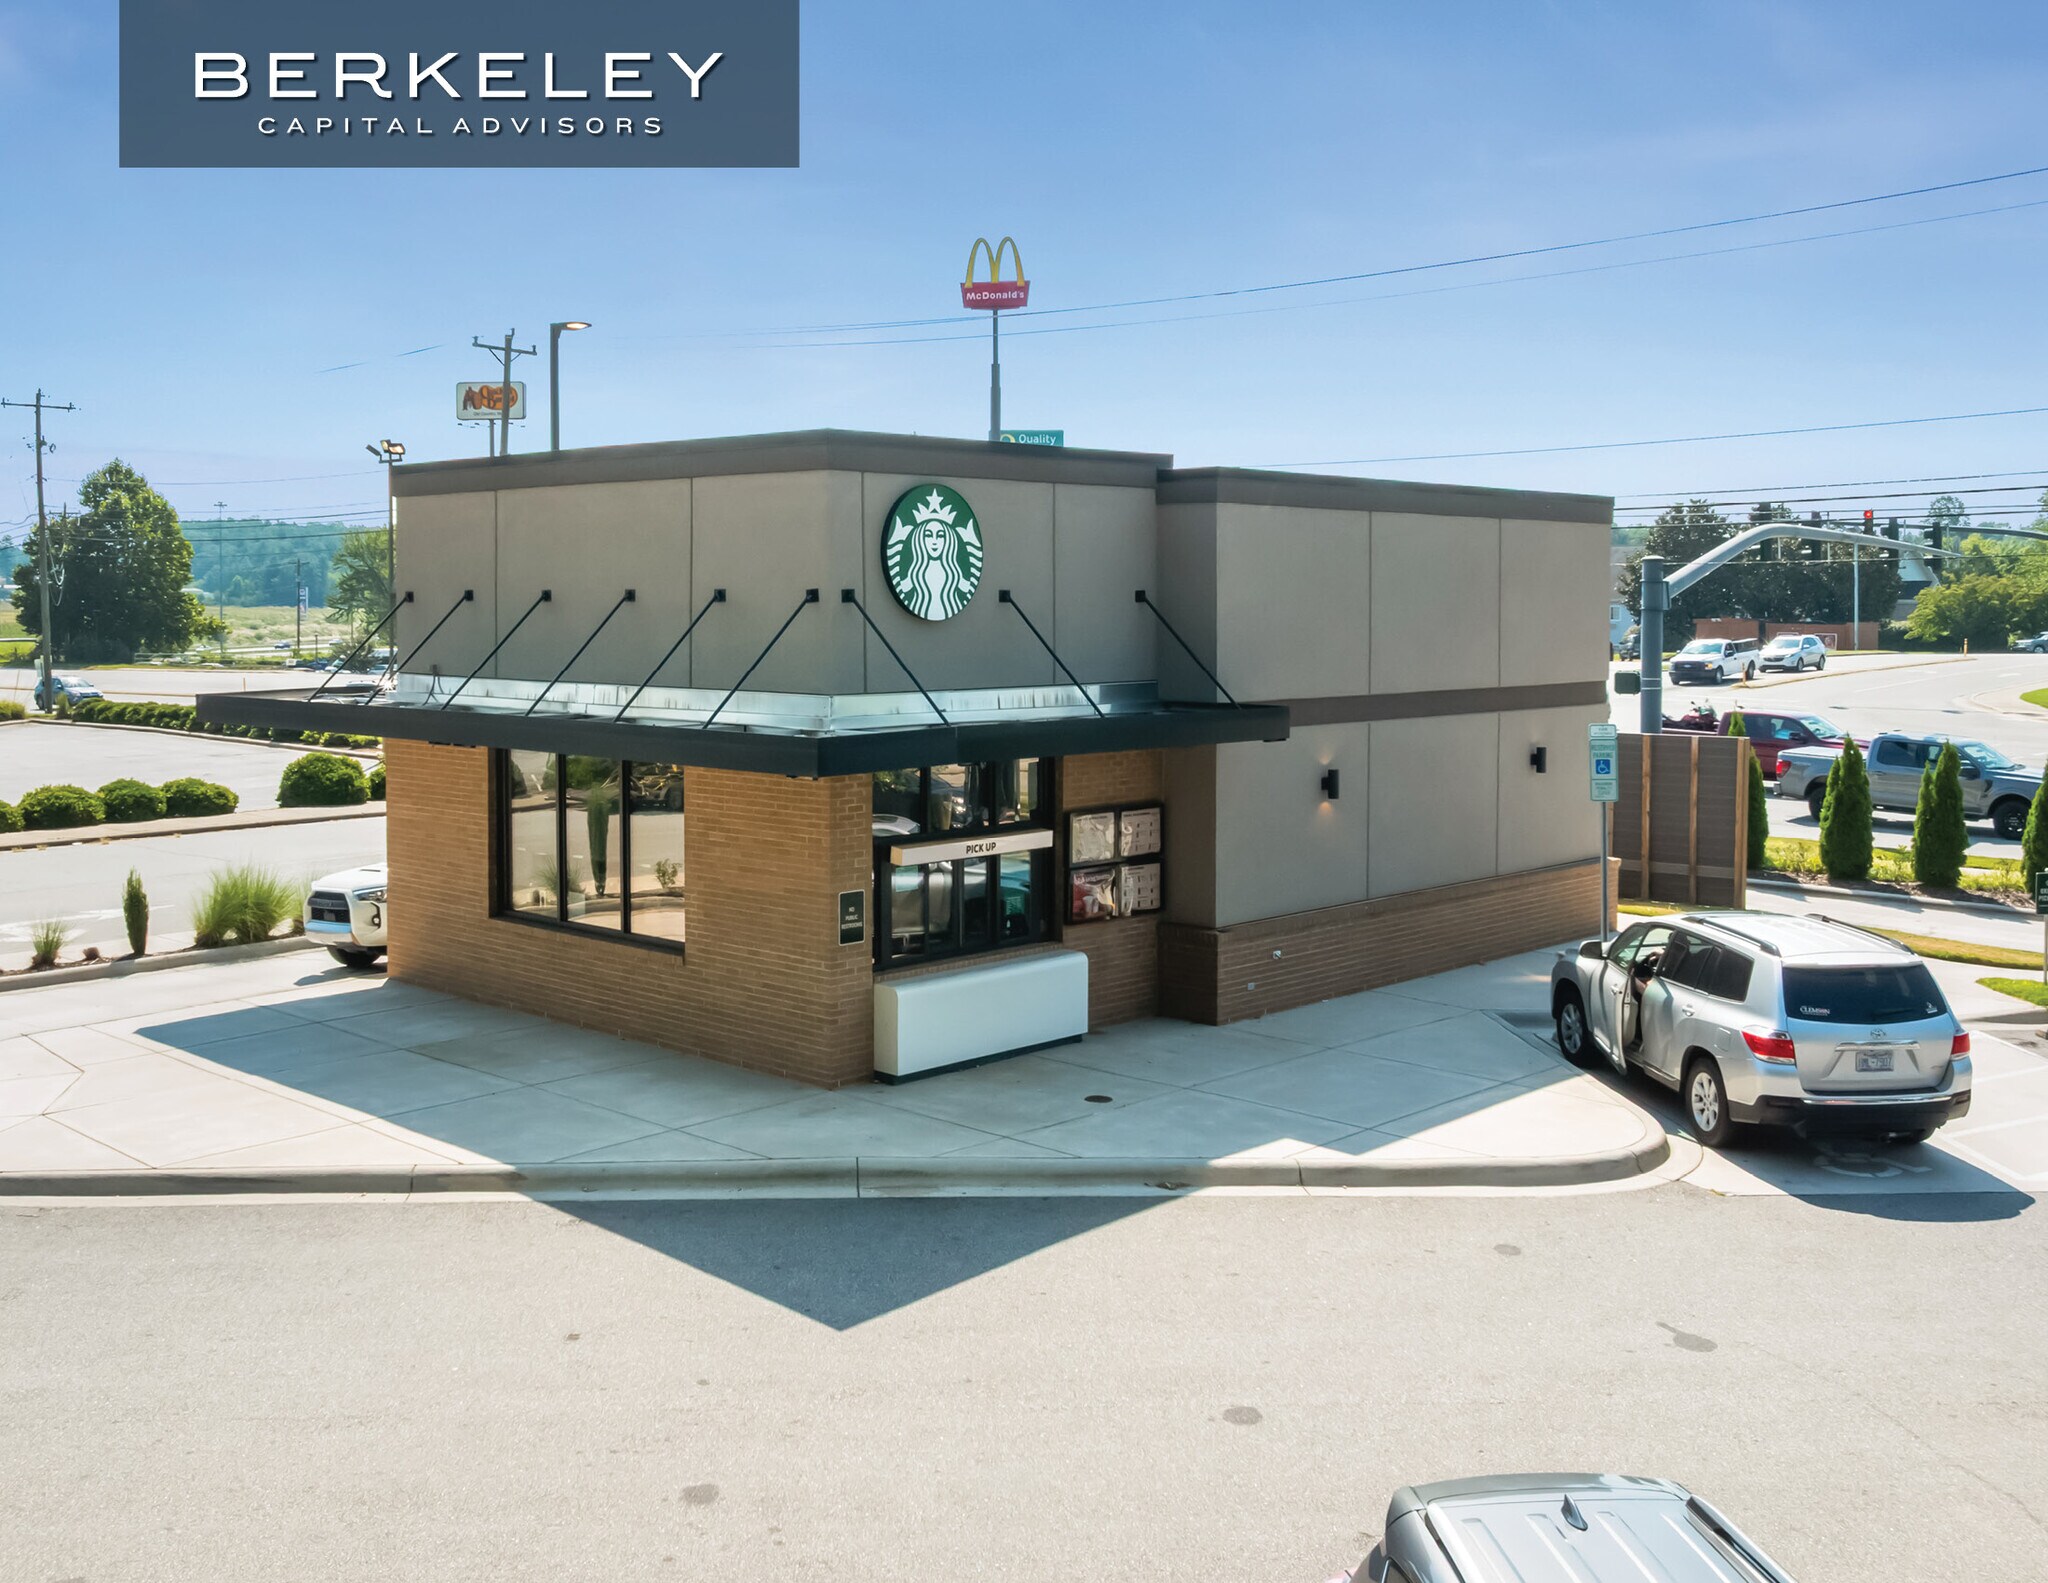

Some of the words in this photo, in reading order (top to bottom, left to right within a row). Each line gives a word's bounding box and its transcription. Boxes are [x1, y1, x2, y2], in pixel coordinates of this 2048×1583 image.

[966, 291, 1024, 300] McDonald's
[1018, 434, 1056, 446] Quality
[966, 843, 984, 854] PICK
[985, 841, 997, 852] UP
